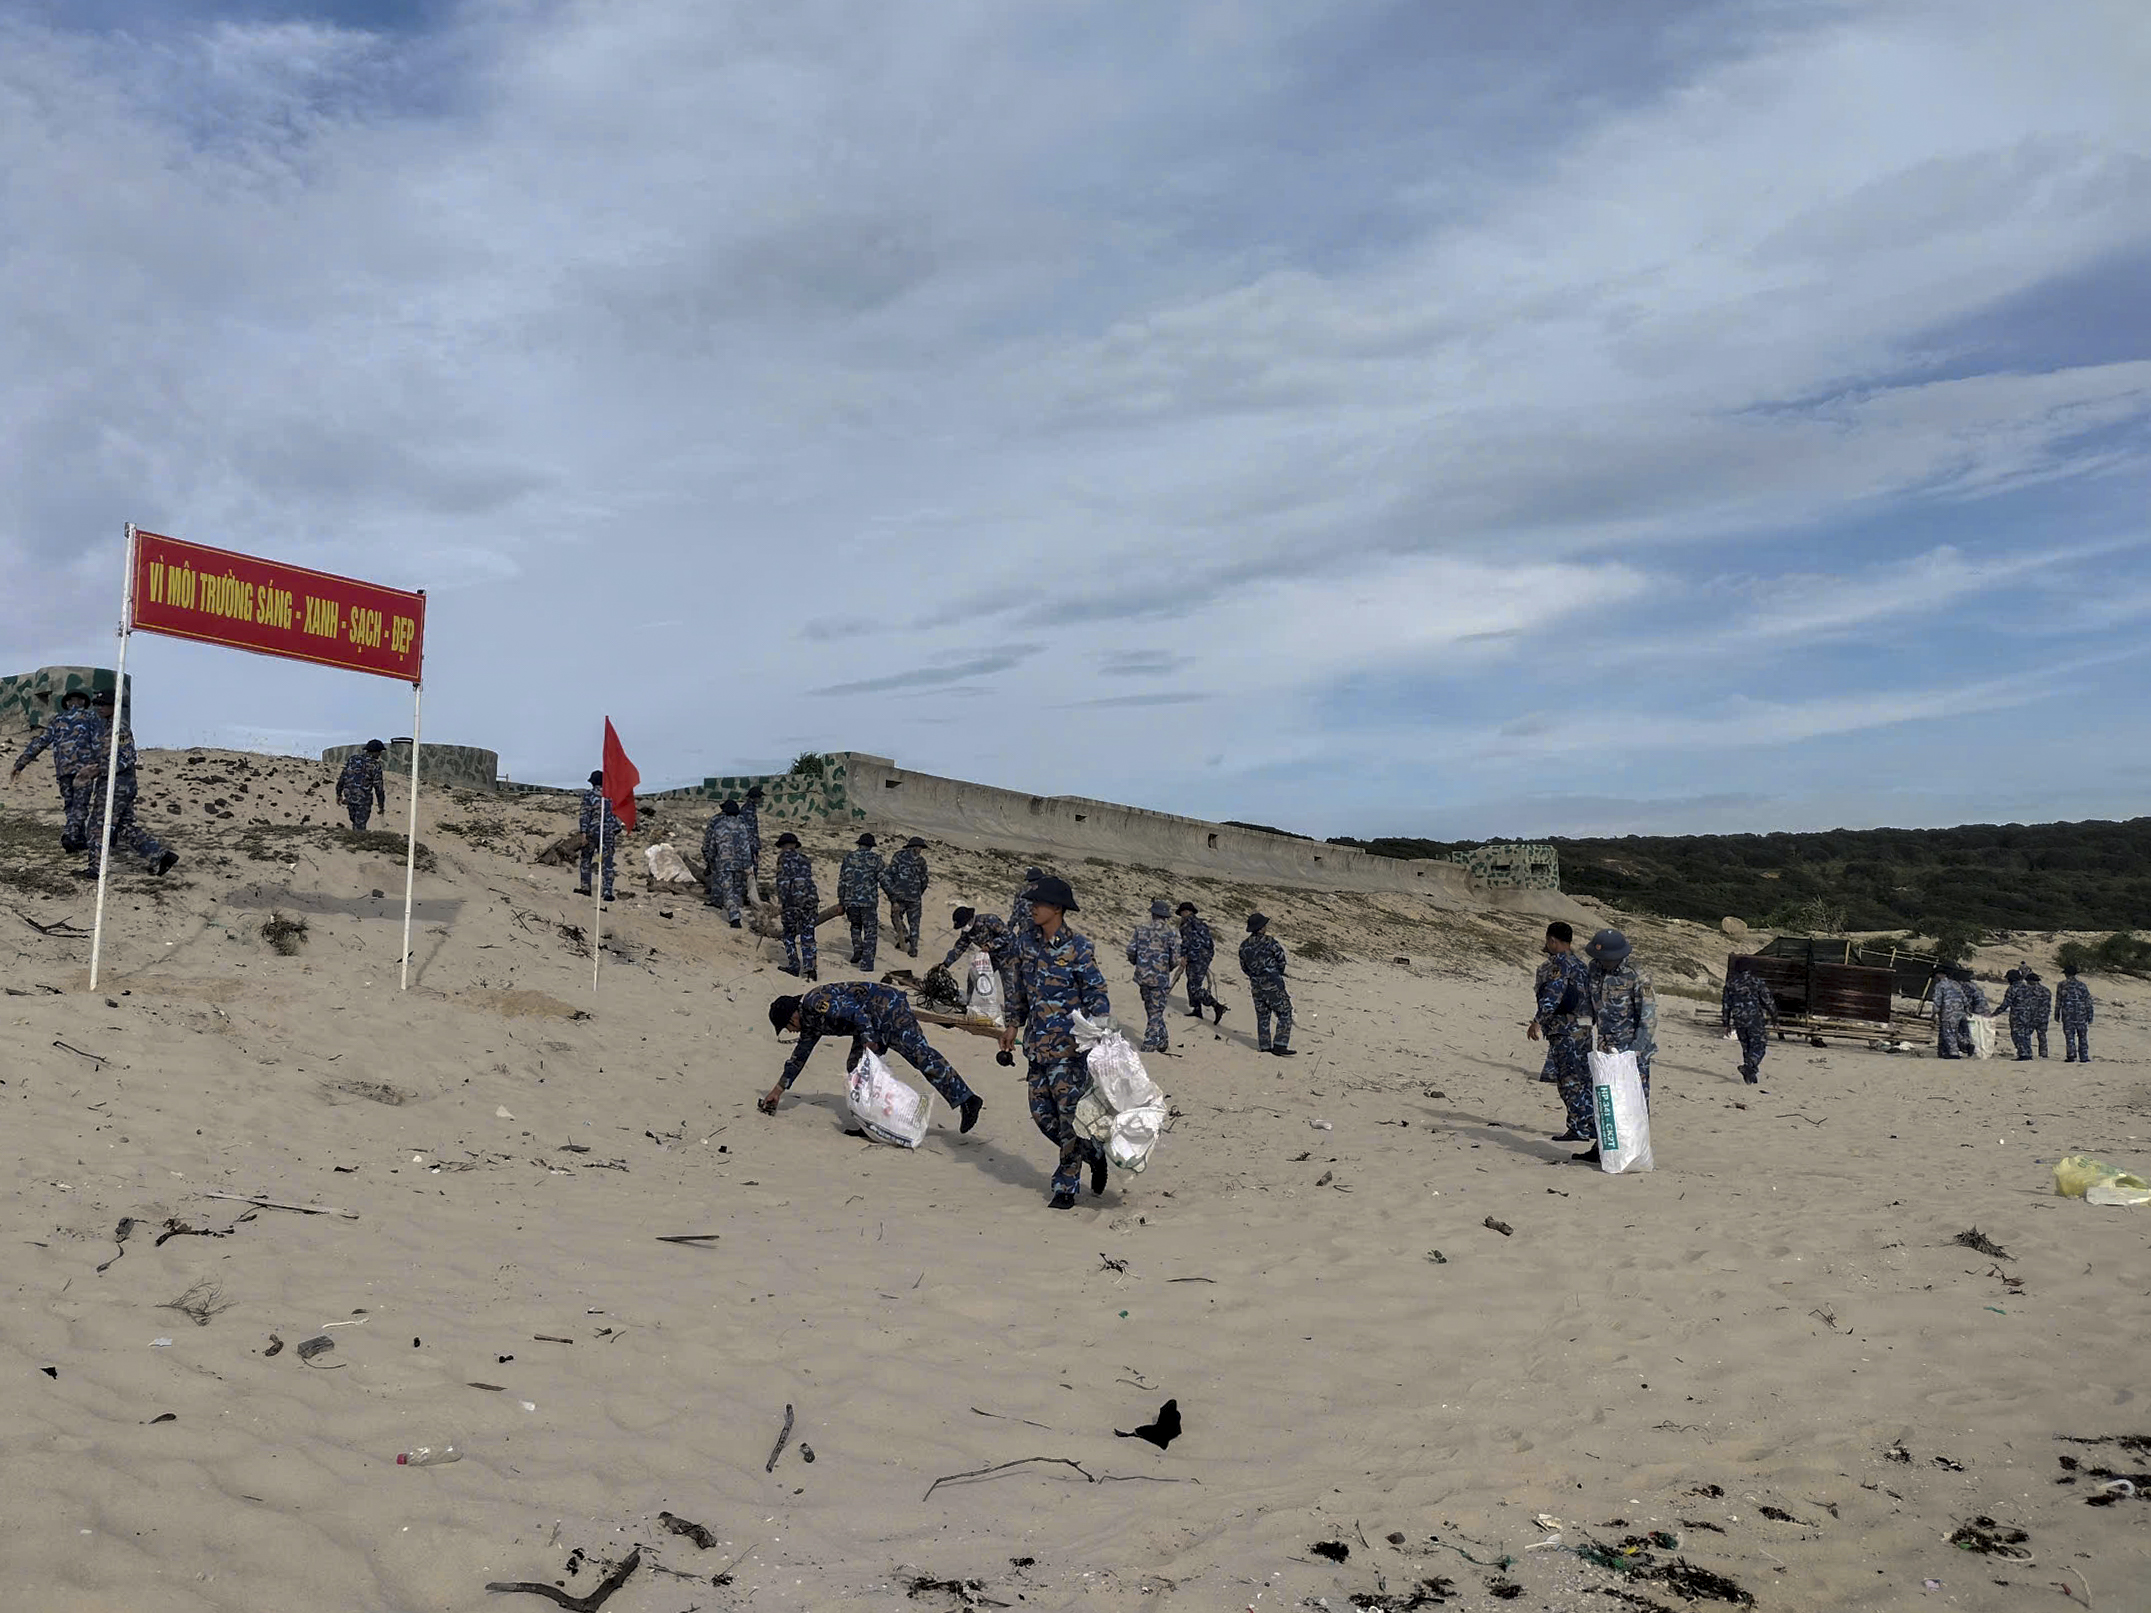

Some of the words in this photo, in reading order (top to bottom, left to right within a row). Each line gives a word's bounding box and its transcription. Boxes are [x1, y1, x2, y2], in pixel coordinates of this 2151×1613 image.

[150, 556, 165, 602] VÌ
[167, 560, 196, 610] MÔI
[199, 569, 253, 621] TRƯỜNG
[257, 579, 293, 630] SÁNG
[303, 596, 339, 639] XANH
[349, 606, 382, 653] SẠCH
[391, 615, 415, 662] ĐẸP
[1600, 1087, 1609, 1100] HP
